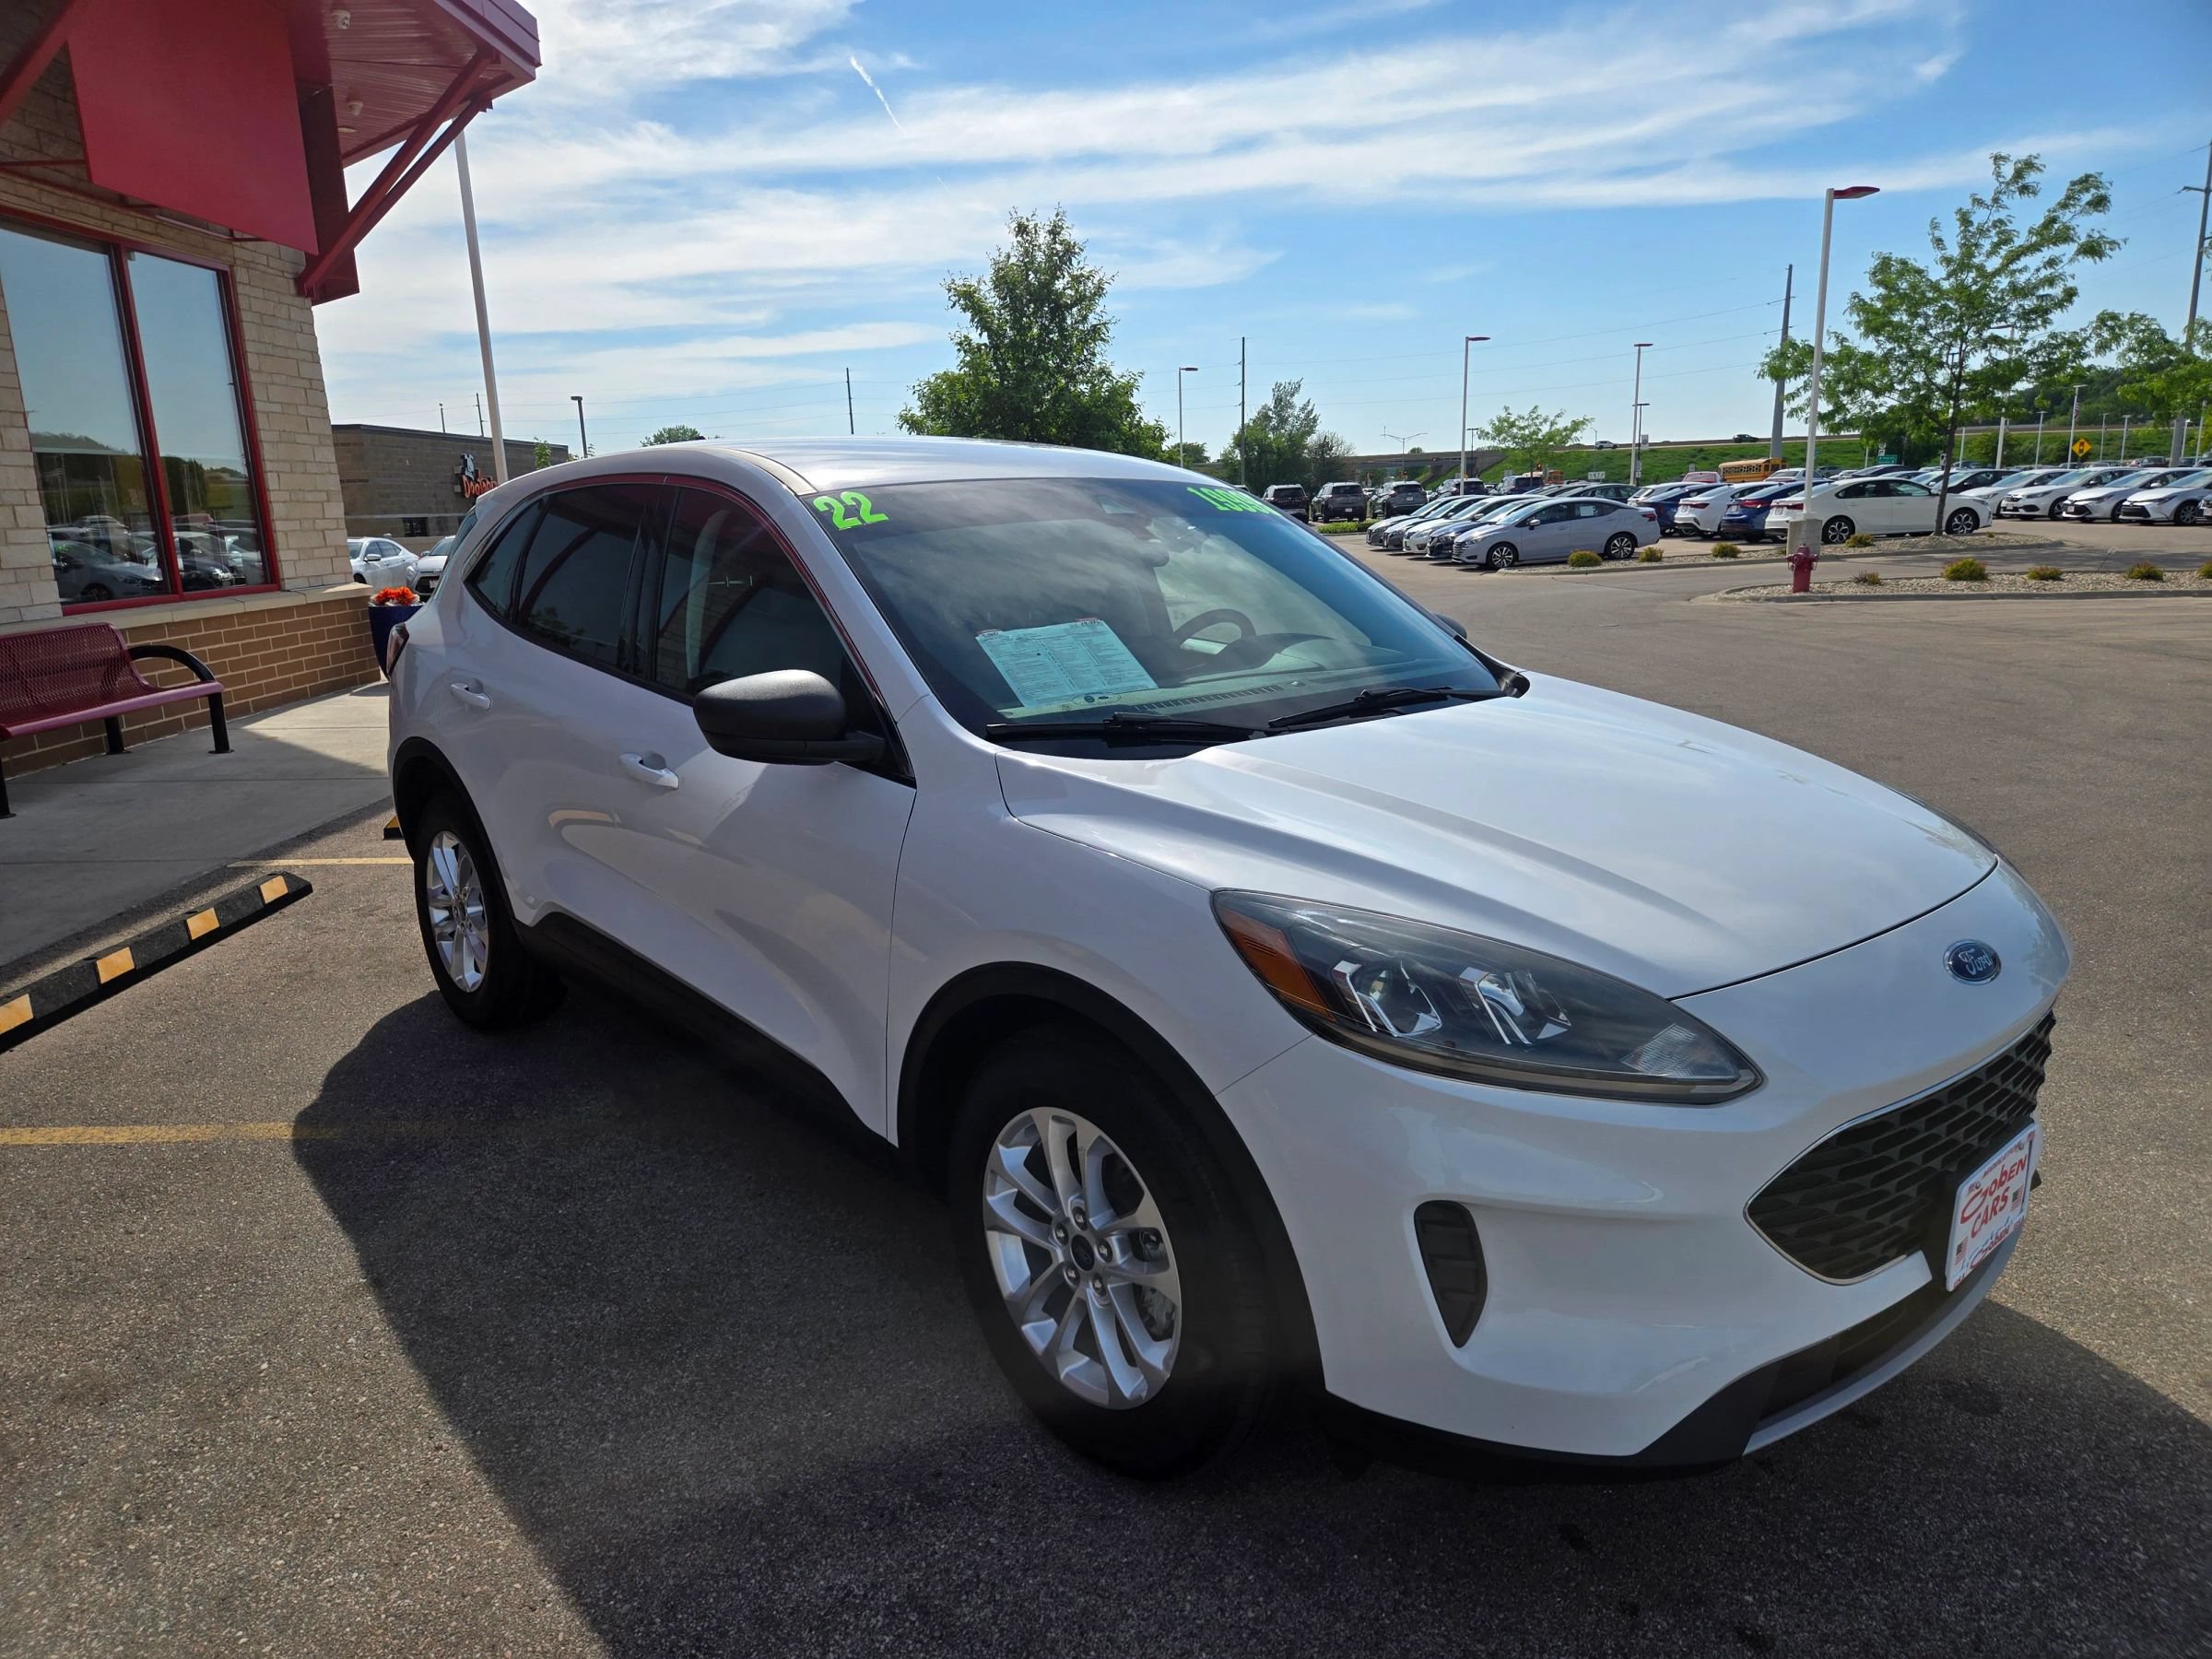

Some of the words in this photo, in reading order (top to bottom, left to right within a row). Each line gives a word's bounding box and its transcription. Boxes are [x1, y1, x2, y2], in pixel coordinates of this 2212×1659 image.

[813, 490, 889, 531] 22
[1186, 487, 1283, 517] 1999
[1958, 947, 1994, 976] Ford
[1971, 1186, 2011, 1239] CARS
